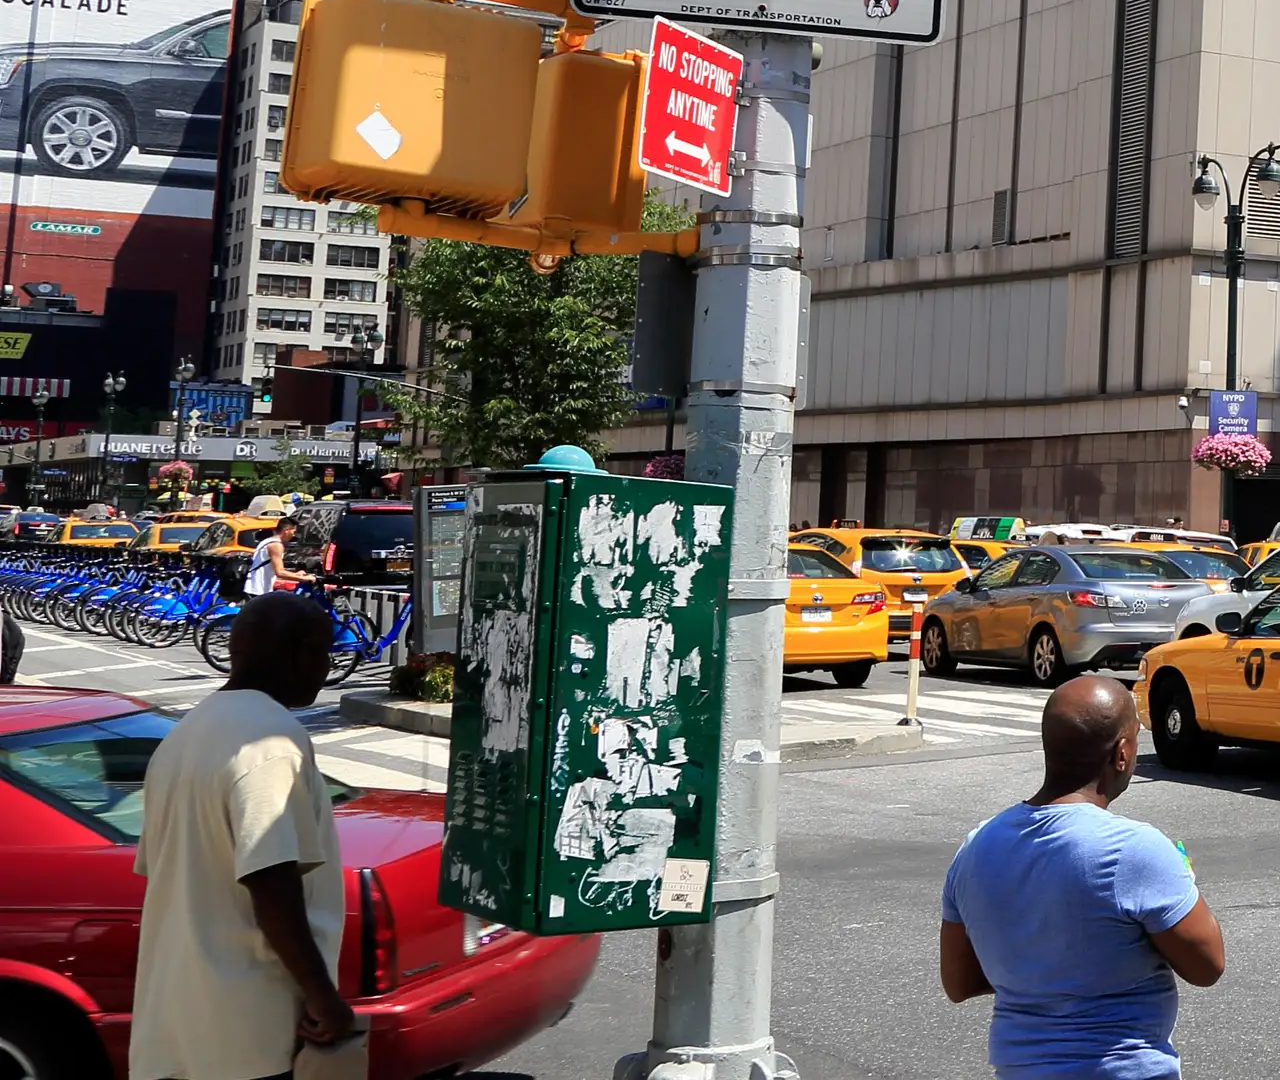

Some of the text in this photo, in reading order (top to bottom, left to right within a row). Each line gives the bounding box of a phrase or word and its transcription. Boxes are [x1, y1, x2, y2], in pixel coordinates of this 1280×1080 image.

[680, 4, 842, 27] DEPT OF TRANSPORTATION
[658, 41, 734, 98] NO STOPPING
[666, 88, 718, 132] ANYTIME
[37, 223, 94, 234] LAMAR
[1222, 394, 1245, 402] NYPD
[1218, 416, 1249, 426] Security
[1218, 424, 1248, 433] Camera
[236, 443, 258, 457] DR
